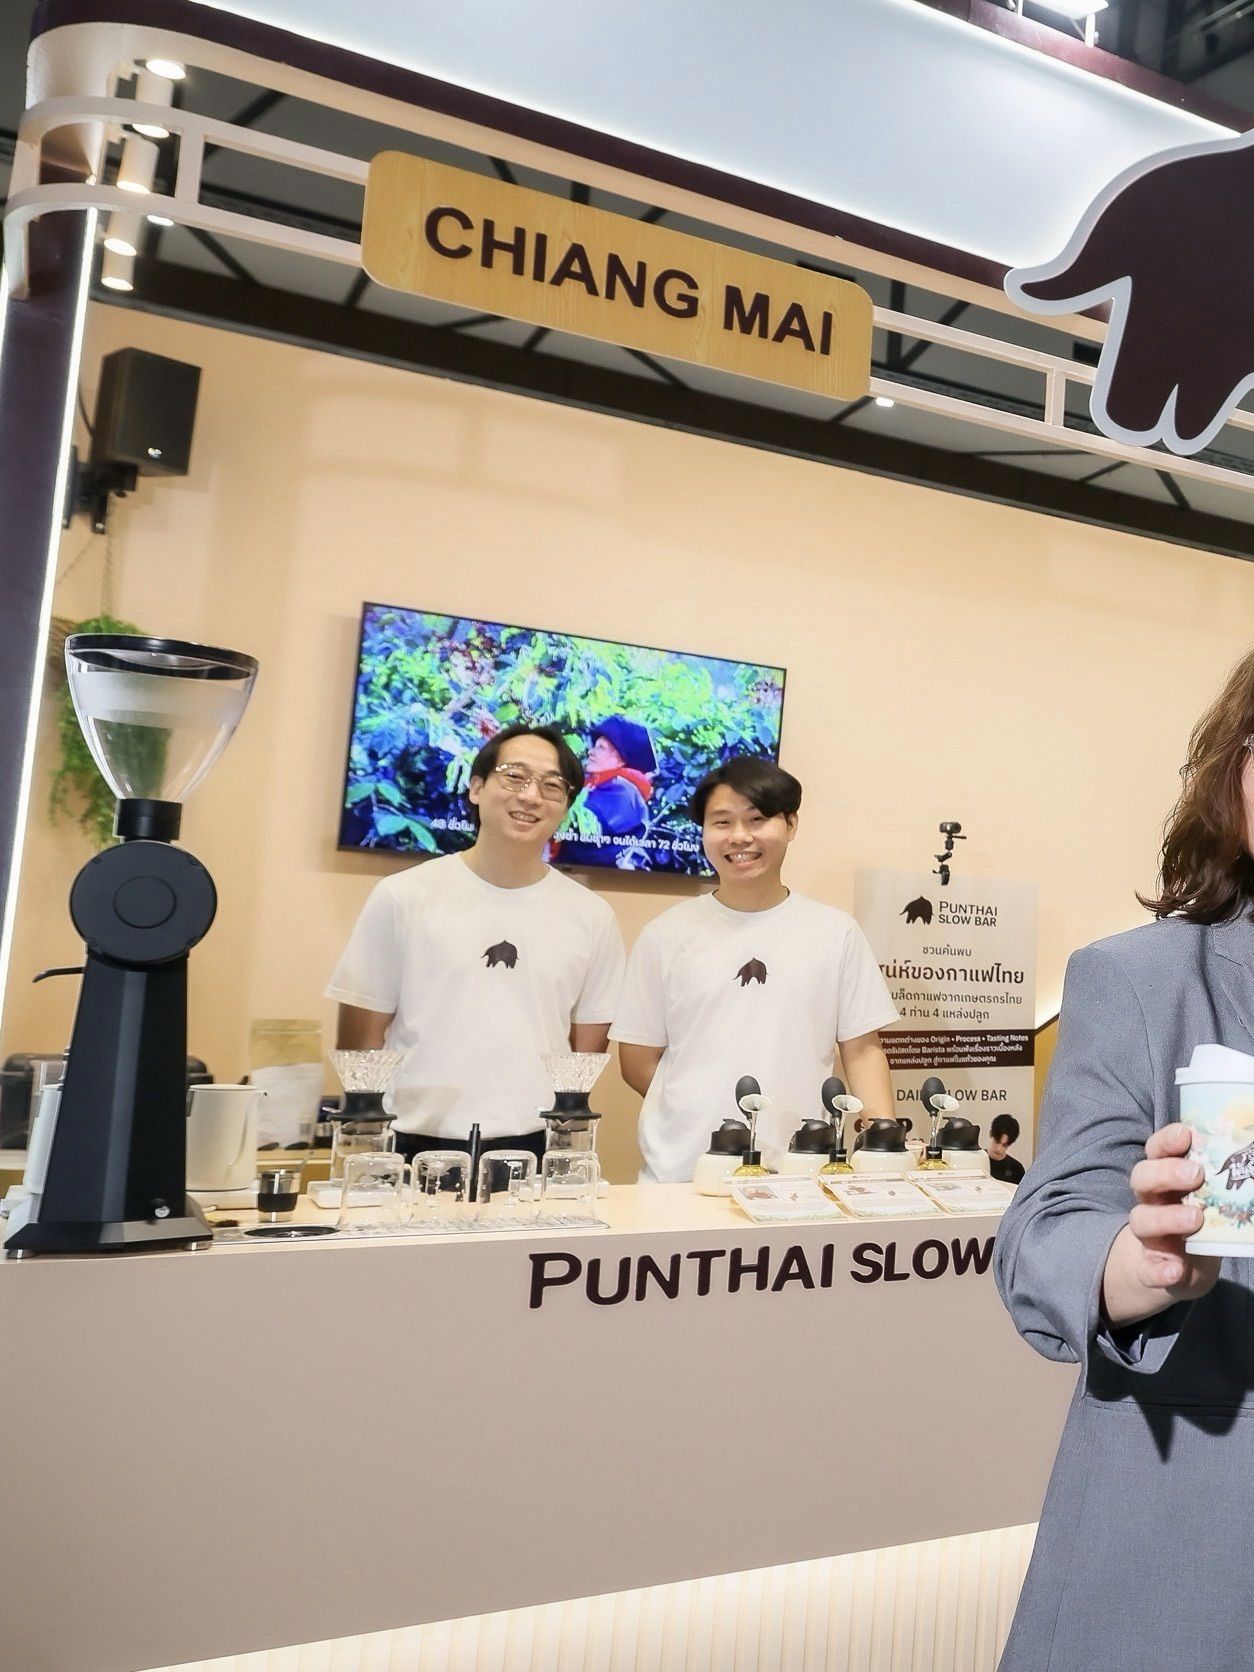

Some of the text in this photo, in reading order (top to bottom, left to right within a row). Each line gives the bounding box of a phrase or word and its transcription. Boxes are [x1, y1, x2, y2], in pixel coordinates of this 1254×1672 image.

[424, 206, 833, 357] CHIANG MAI
[658, 838, 671, 851] 72
[939, 901, 998, 916] PUNTHAI
[938, 914, 997, 927] SLOW BAR
[922, 944, 972, 957] ชวนค้นพบ
[878, 959, 1024, 984] น่ห์ของกาแฟไทย
[891, 988, 1022, 1005] มล็ดกาแฟจากเกษตรกรไทย
[900, 1006, 990, 1024] 4 ท่าน 4 แหล่งปลูก
[930, 1035, 950, 1045] Origin
[955, 1034, 981, 1043] Process
[986, 1034, 1009, 1044] Tasting
[1010, 1034, 1029, 1042] Notes
[922, 1046, 945, 1054] Barista
[896, 1089, 921, 1101] DAI
[981, 1089, 1008, 1101] BAR
[528, 1236, 997, 1309] PUNTHAI SLOW
